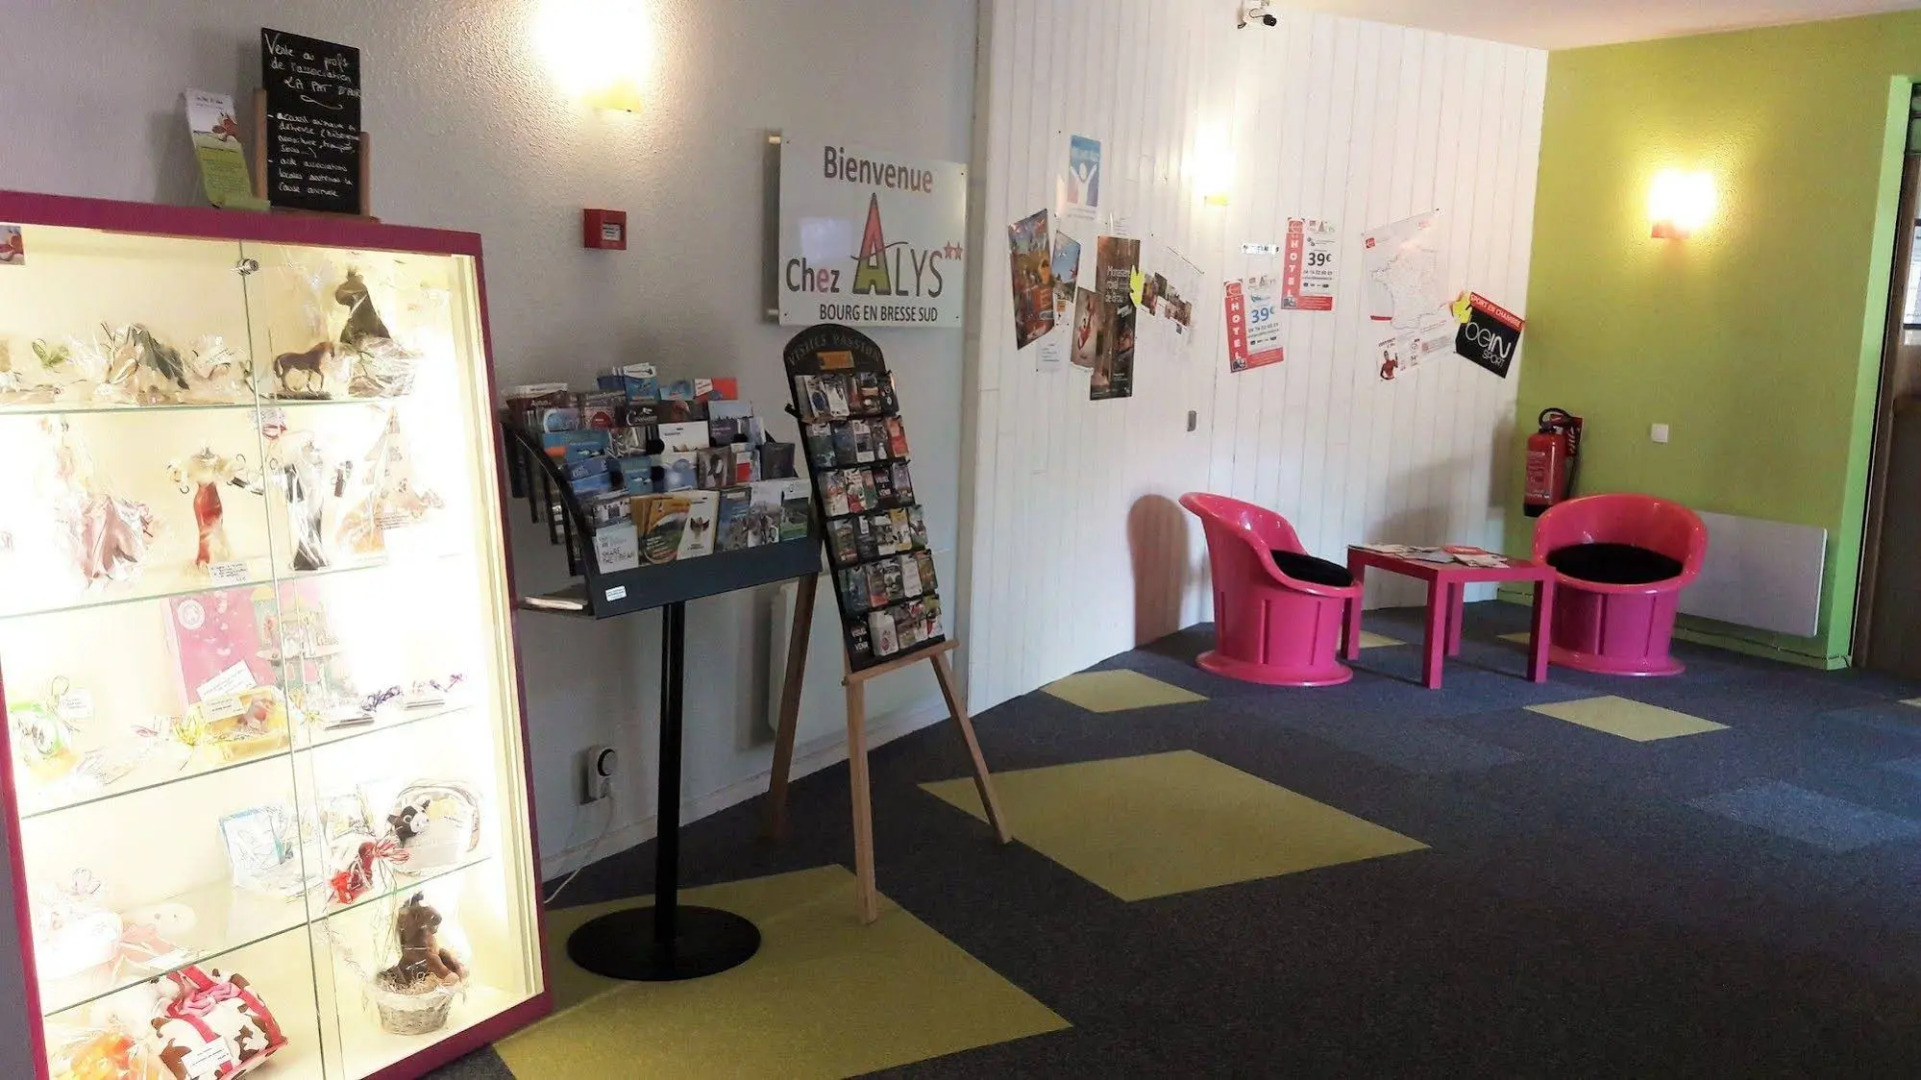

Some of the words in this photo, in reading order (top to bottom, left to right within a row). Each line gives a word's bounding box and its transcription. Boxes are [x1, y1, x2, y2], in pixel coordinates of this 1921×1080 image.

[271, 57, 285, 70] de
[824, 145, 933, 193] Bienvenue
[785, 257, 840, 293] Chez
[851, 192, 943, 298] ALYS
[1307, 252, 1332, 267] 39€
[1288, 240, 1299, 298] HOTEL
[819, 303, 860, 321] BOURG
[864, 305, 878, 321] EN
[880, 306, 917, 322] BRESSE
[918, 307, 938, 322] SUD
[1230, 302, 1242, 360] HOTEL
[1482, 349, 1505, 368] SPORT
